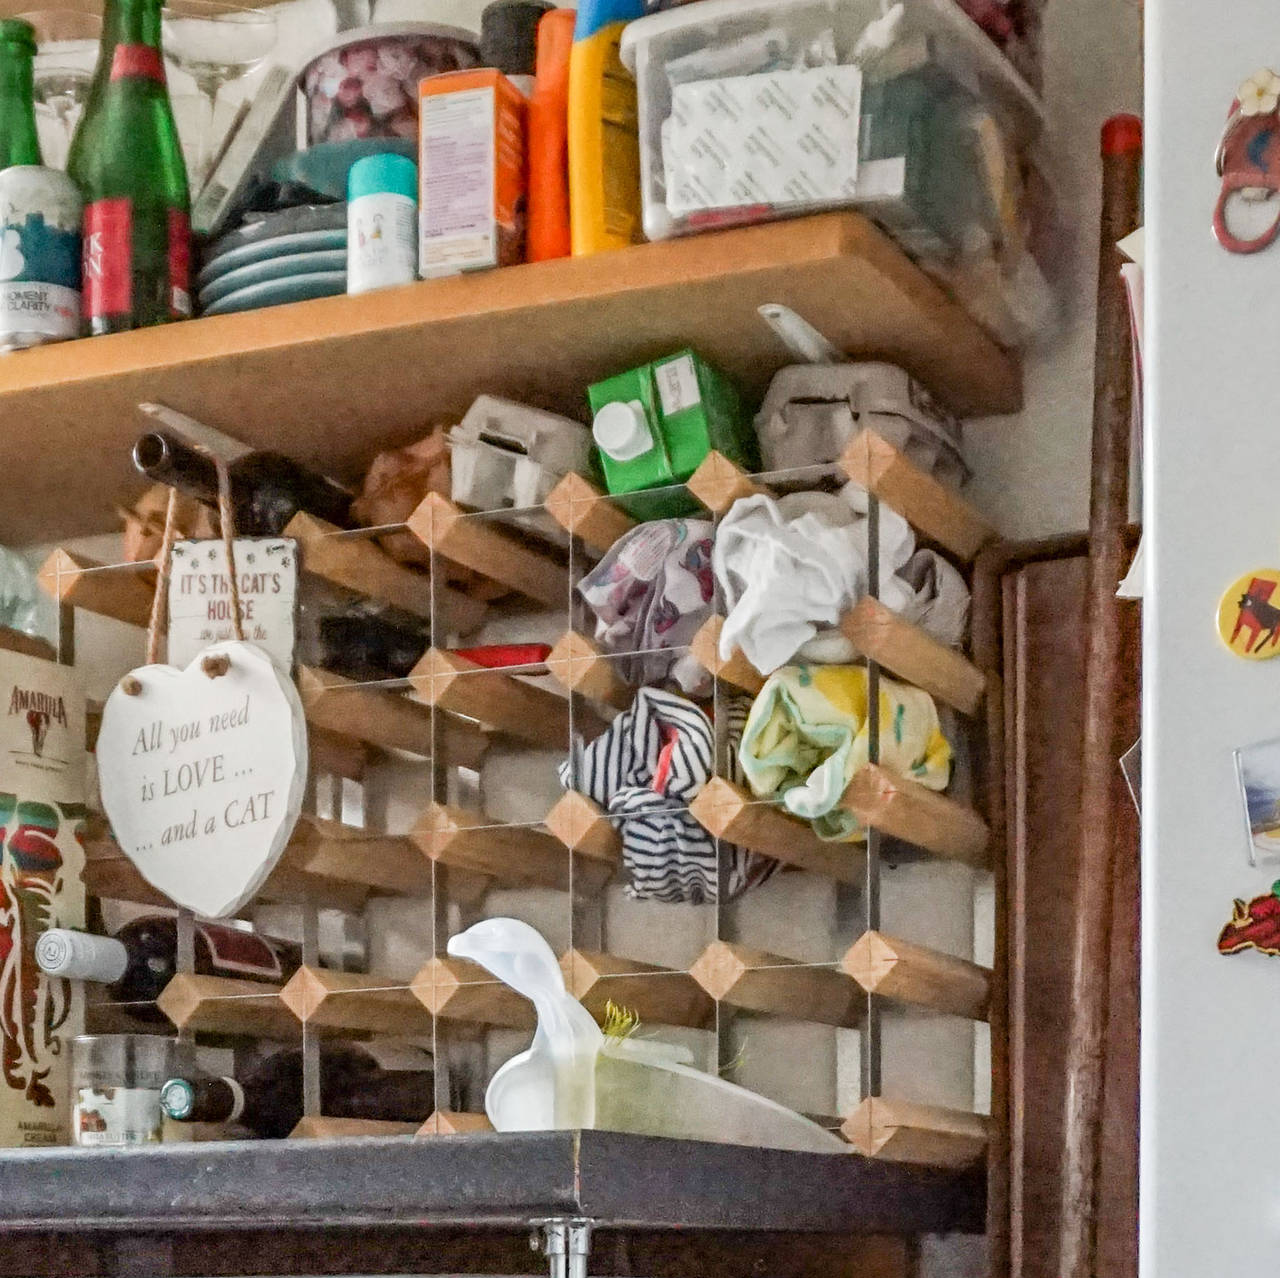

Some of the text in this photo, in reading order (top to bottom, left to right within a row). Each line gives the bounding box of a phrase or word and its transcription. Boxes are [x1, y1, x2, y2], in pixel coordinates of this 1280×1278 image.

[180, 572, 281, 595] IT'S CAT'S
[7, 685, 68, 729] AMARULA
[132, 694, 250, 755] All you need
[141, 774, 155, 802] is
[162, 753, 225, 797] LOVE
[161, 808, 198, 846] and
[204, 815, 217, 834] a
[224, 790, 275, 829] CAT
